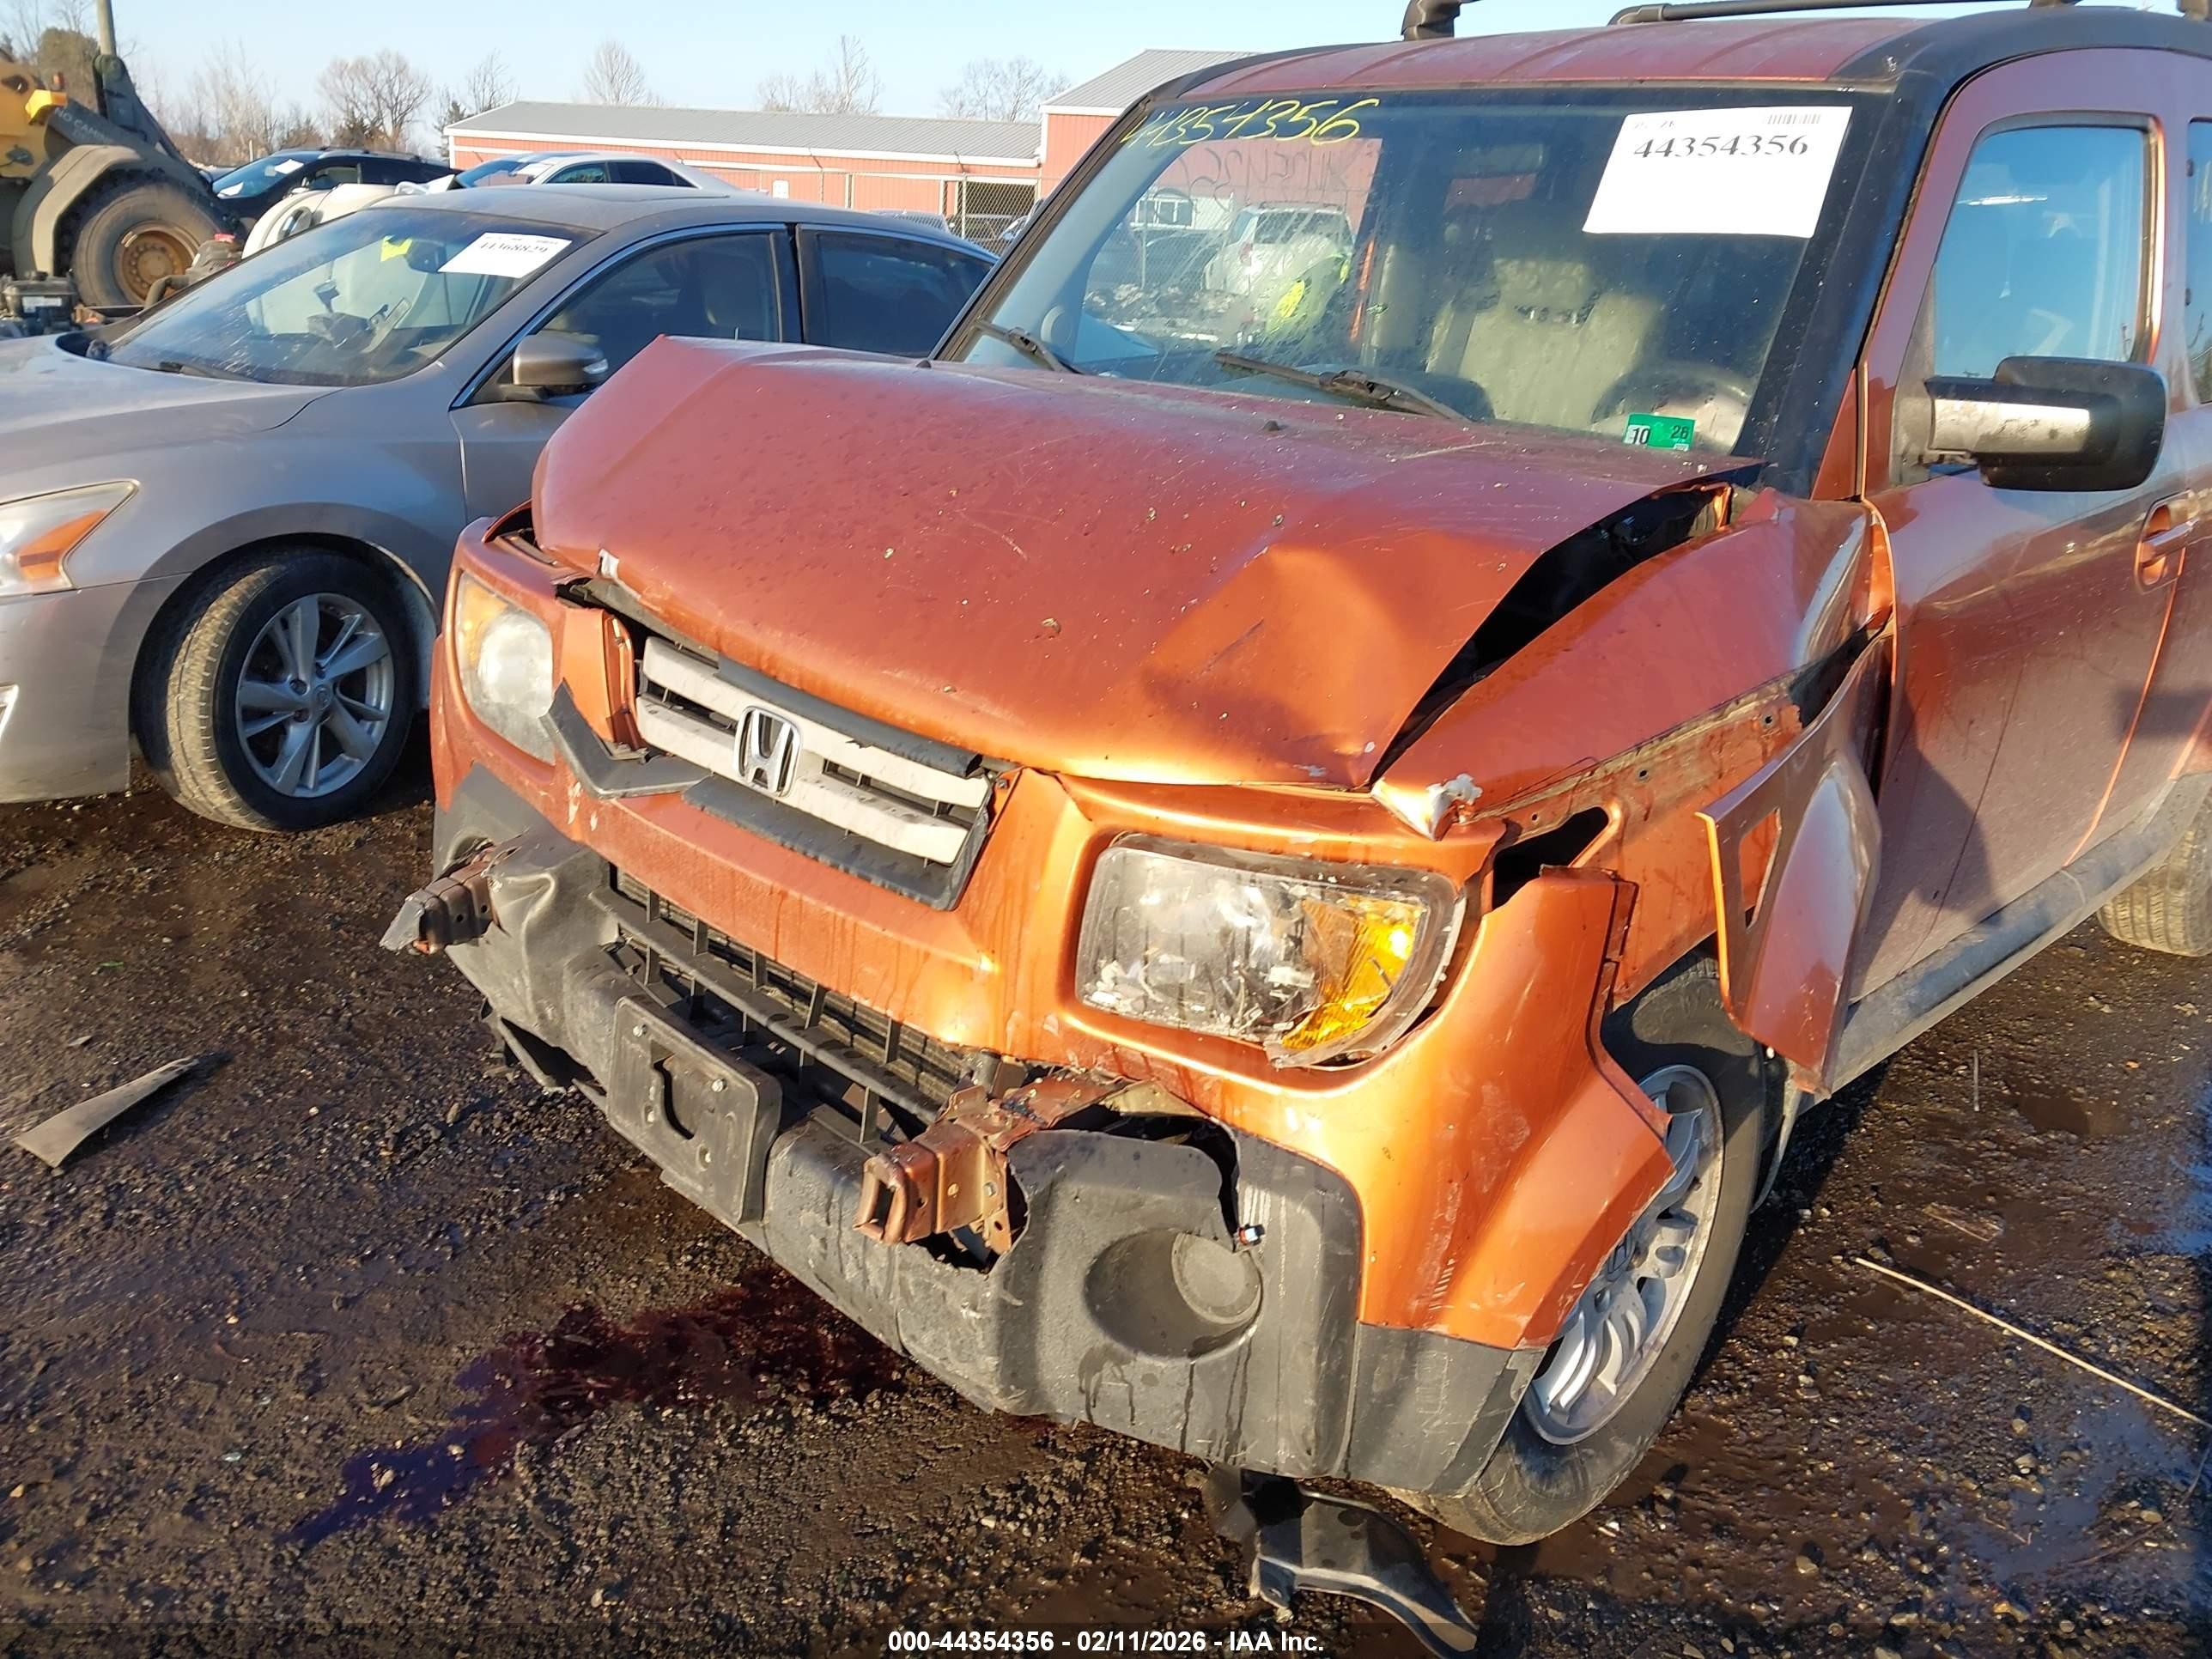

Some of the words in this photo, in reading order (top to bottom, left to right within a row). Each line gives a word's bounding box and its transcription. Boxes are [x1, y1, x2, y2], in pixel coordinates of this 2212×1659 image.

[1633, 134, 1809, 158] 44354356
[1631, 427, 1650, 445] 10
[1670, 425, 1689, 440] 26
